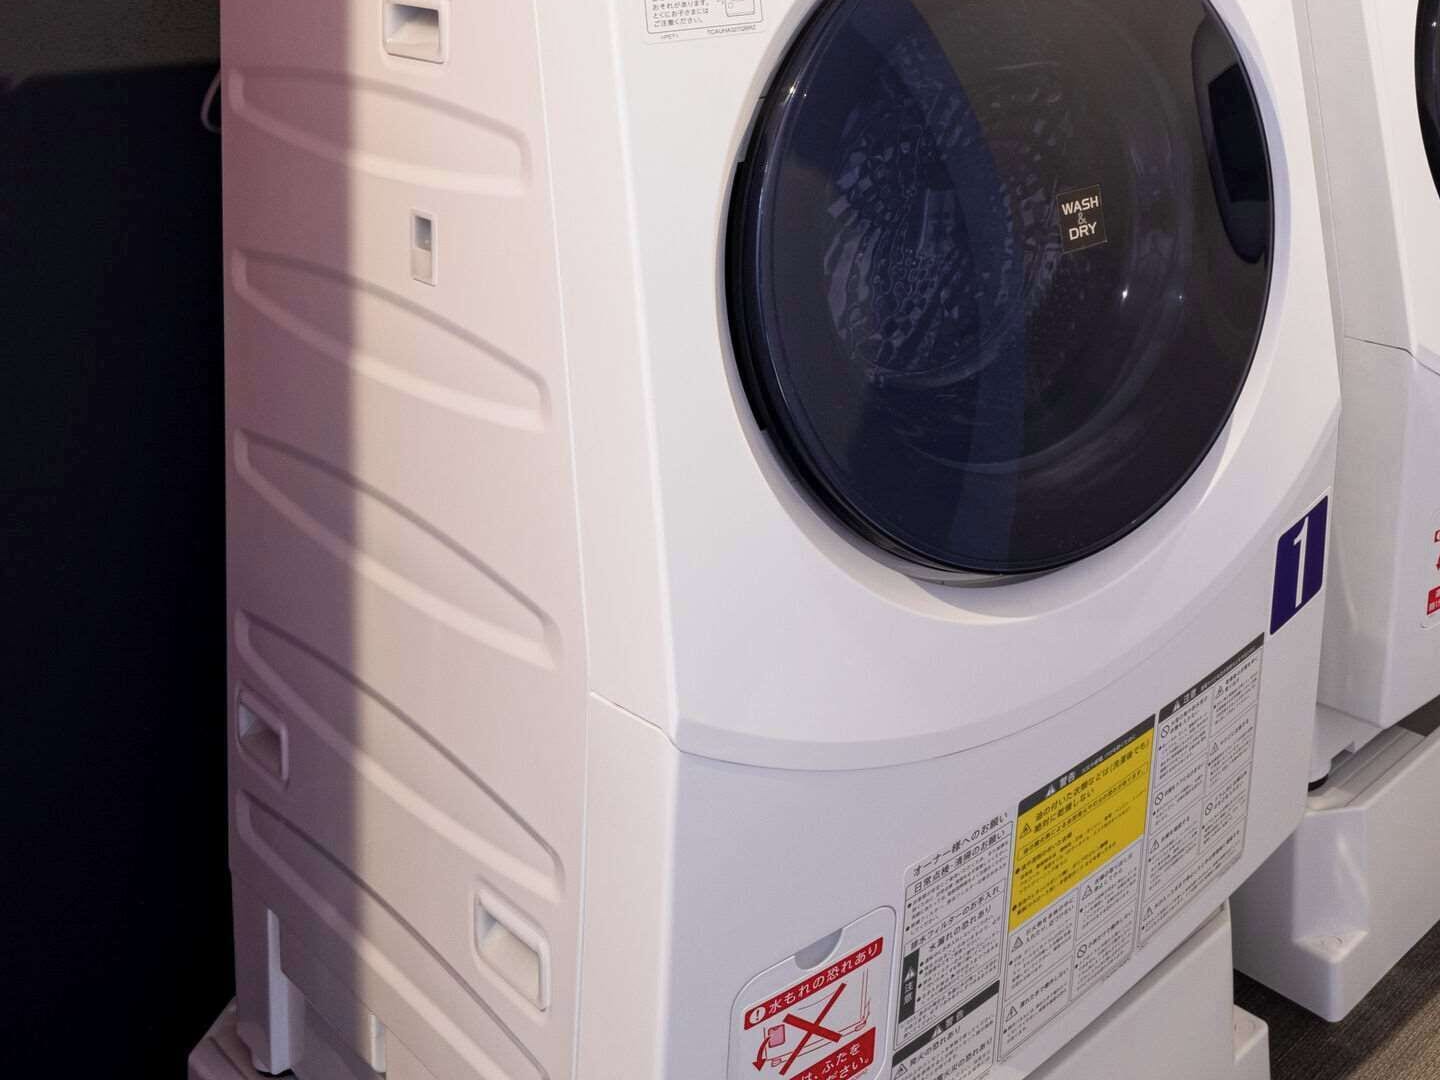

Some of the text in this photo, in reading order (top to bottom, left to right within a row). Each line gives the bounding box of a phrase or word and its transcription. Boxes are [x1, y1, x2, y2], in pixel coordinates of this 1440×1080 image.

[1061, 195, 1100, 216] WASH
[1077, 211, 1087, 225] &
[1068, 221, 1097, 241] DRY
[1292, 515, 1309, 609] 1
[913, 812, 1008, 877] オーナー様へのお願い
[768, 943, 878, 1015] 水もれの恐れあり
